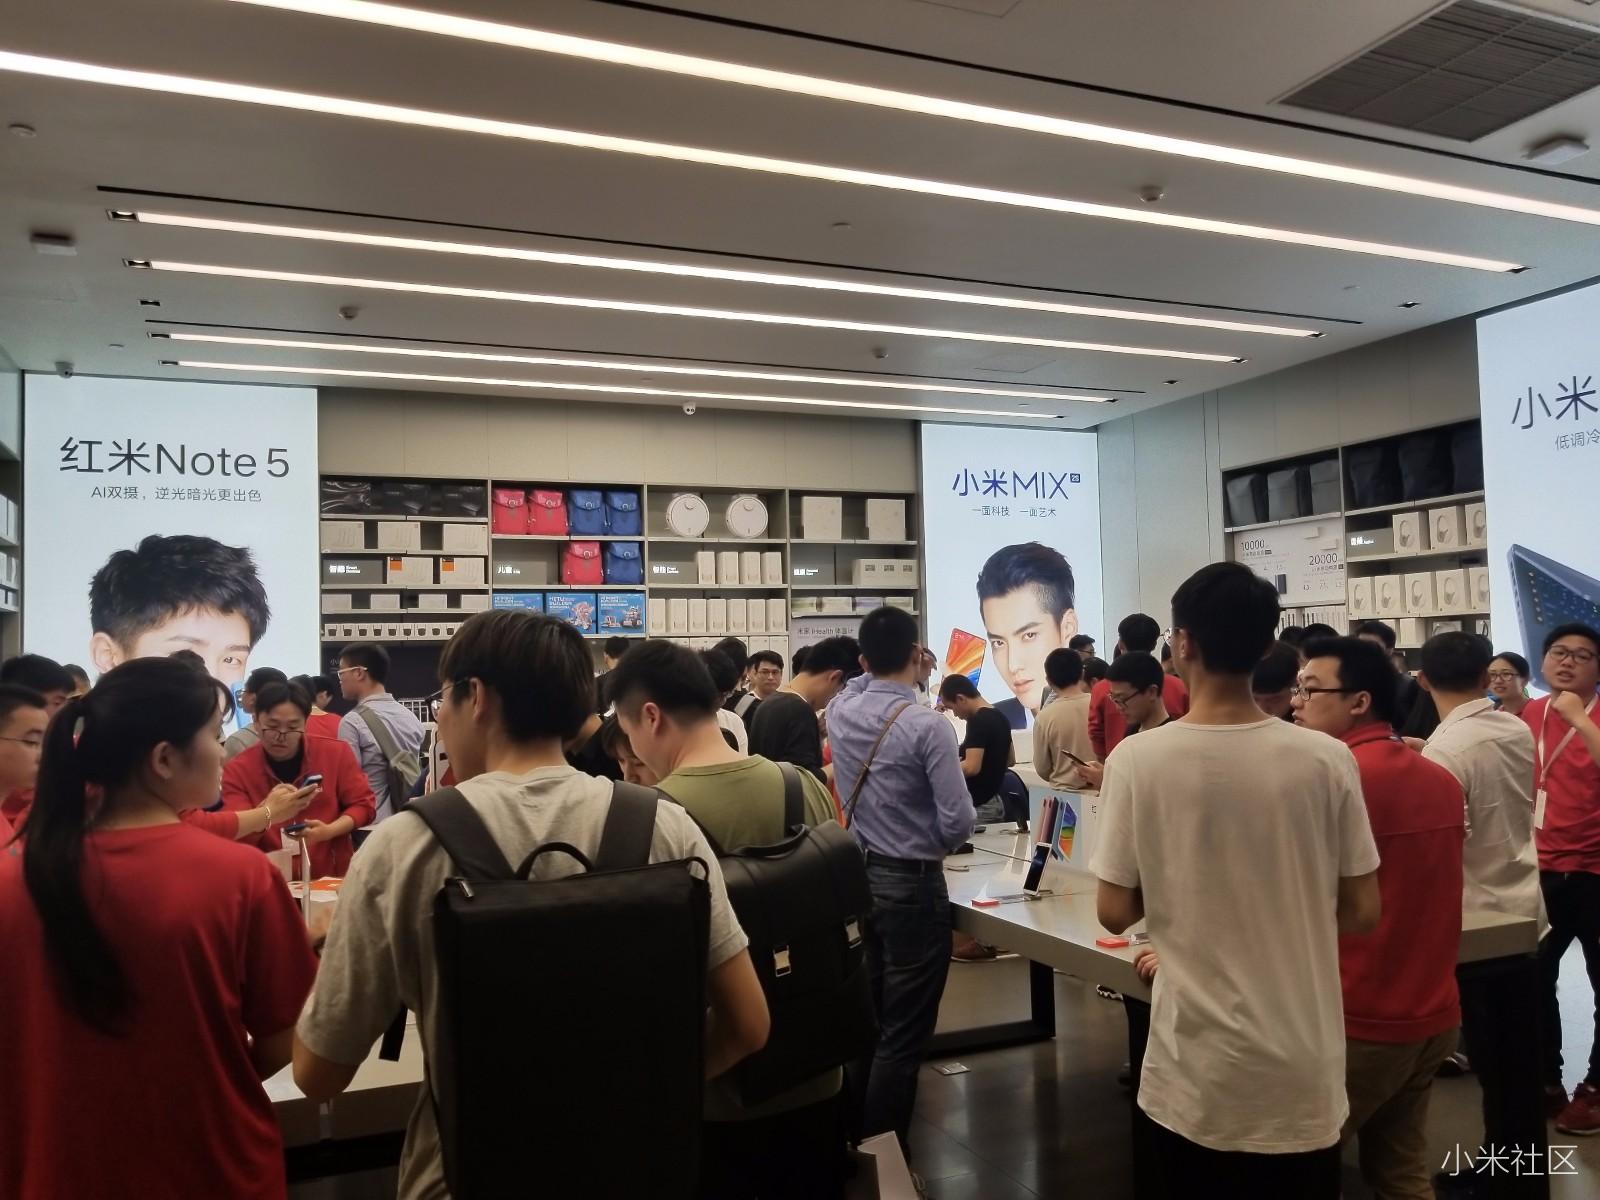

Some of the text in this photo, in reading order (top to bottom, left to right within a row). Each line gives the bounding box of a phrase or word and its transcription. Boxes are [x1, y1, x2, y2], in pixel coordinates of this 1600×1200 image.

[1511, 376, 1598, 429] 小米
[60, 437, 290, 478] 红米Note 5
[952, 468, 1069, 500] 小米MIX
[971, 505, 1010, 517] 一面科技
